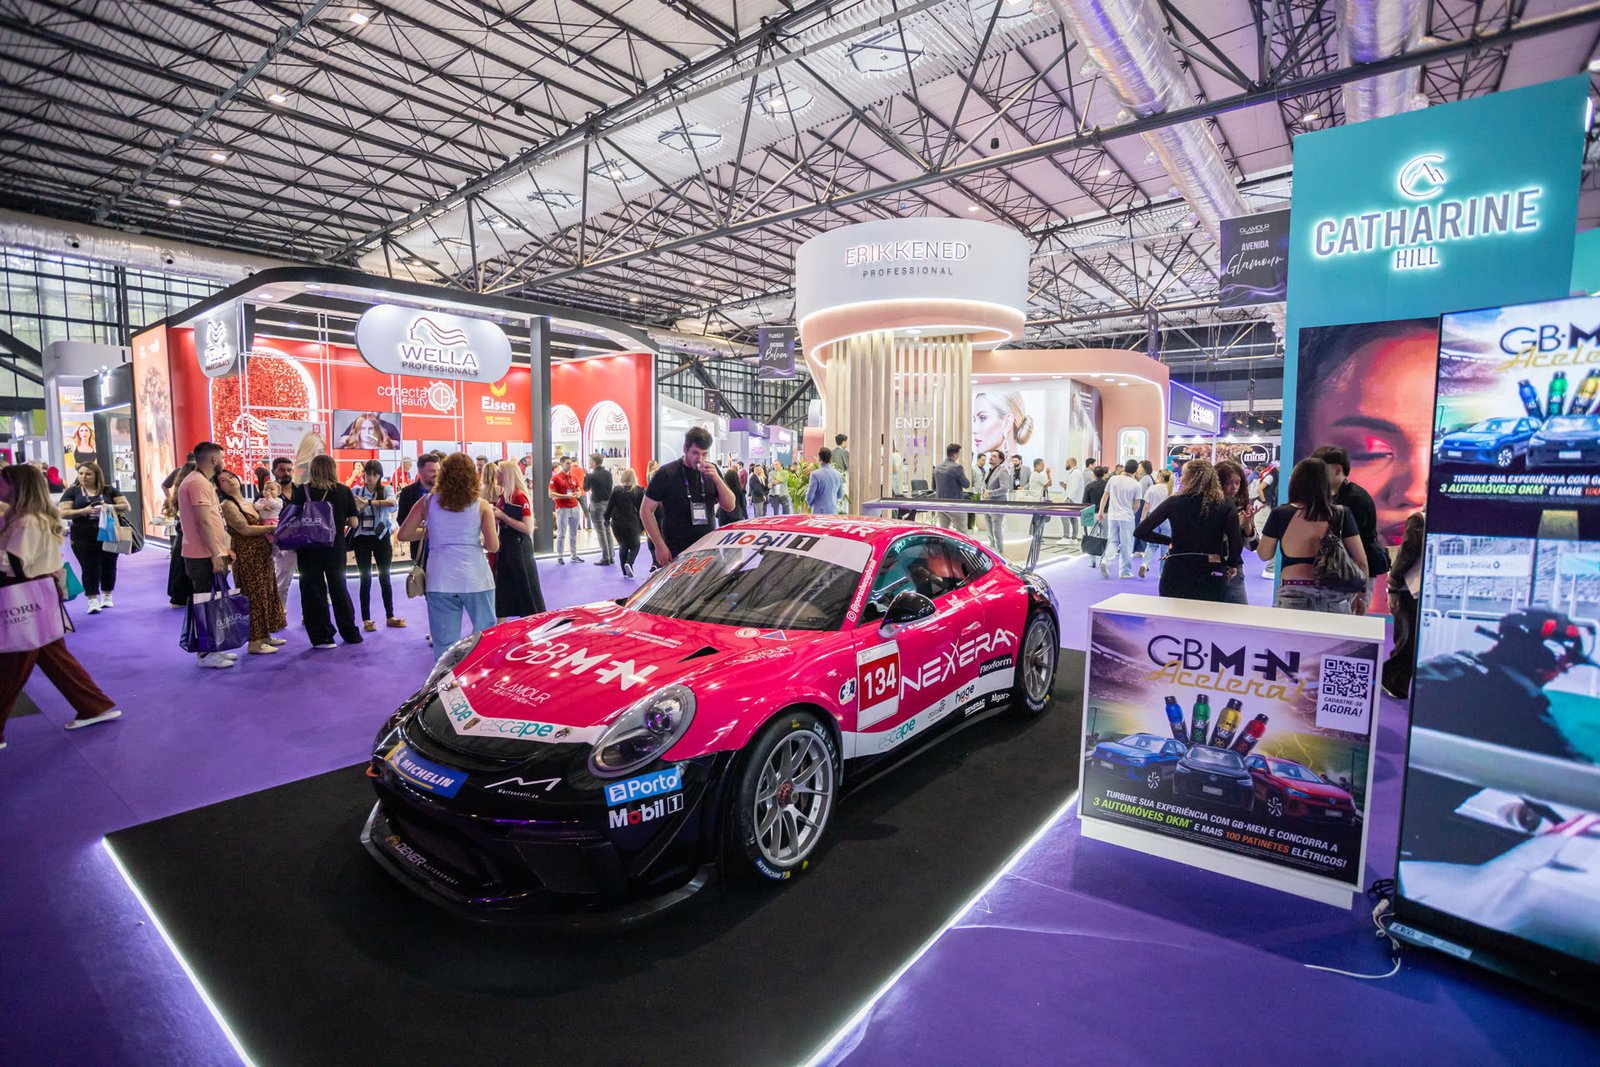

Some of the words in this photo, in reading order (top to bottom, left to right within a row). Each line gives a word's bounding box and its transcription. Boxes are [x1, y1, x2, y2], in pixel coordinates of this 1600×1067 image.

[1315, 188, 1540, 256] CATHARINE
[1241, 239, 1269, 251] AVENIDA
[1226, 251, 1285, 277] Glamour
[1396, 247, 1439, 269] HILL
[862, 266, 953, 279] PROFESSIONAL
[401, 344, 477, 368] WELLA
[401, 361, 479, 376] PROFESSIONALS
[377, 385, 427, 399] conecta
[396, 395, 429, 409] beauty
[481, 395, 516, 412] Eisen
[560, 426, 581, 434] WELLA
[604, 423, 628, 432] WELLA
[1439, 483, 1448, 493] 3
[1448, 482, 1517, 495] AUTOMÓVEIS
[1488, 475, 1507, 483] SUA
[717, 531, 792, 548] Mobil
[979, 656, 1013, 675] Flexform
[863, 662, 897, 700] 134
[493, 679, 552, 704] GLAMOUR
[1321, 703, 1363, 717] AGORA!
[479, 719, 554, 738] escape
[878, 719, 916, 750] escape
[400, 759, 455, 788] MICHELIN
[627, 774, 678, 798] Porto
[608, 799, 665, 829] Mobil
[1106, 789, 1138, 804] TURBINE
[1138, 796, 1155, 808] SUA
[1156, 801, 1208, 821] EXPERIÊNCIA
[1209, 814, 1231, 826] COM
[1268, 828, 1276, 837] E
[1276, 830, 1329, 850] CONCORRA
[1330, 843, 1338, 853] A
[1092, 796, 1101, 806] 3
[1100, 798, 1165, 822] AUTOMÓVEIS
[1193, 823, 1201, 831] E
[1201, 824, 1224, 837] MAIS
[1225, 831, 1241, 840] 100
[1241, 834, 1290, 854] PATINETES
[1291, 847, 1348, 868] ELÉTRICOS!
[394, 842, 427, 867] DENER
